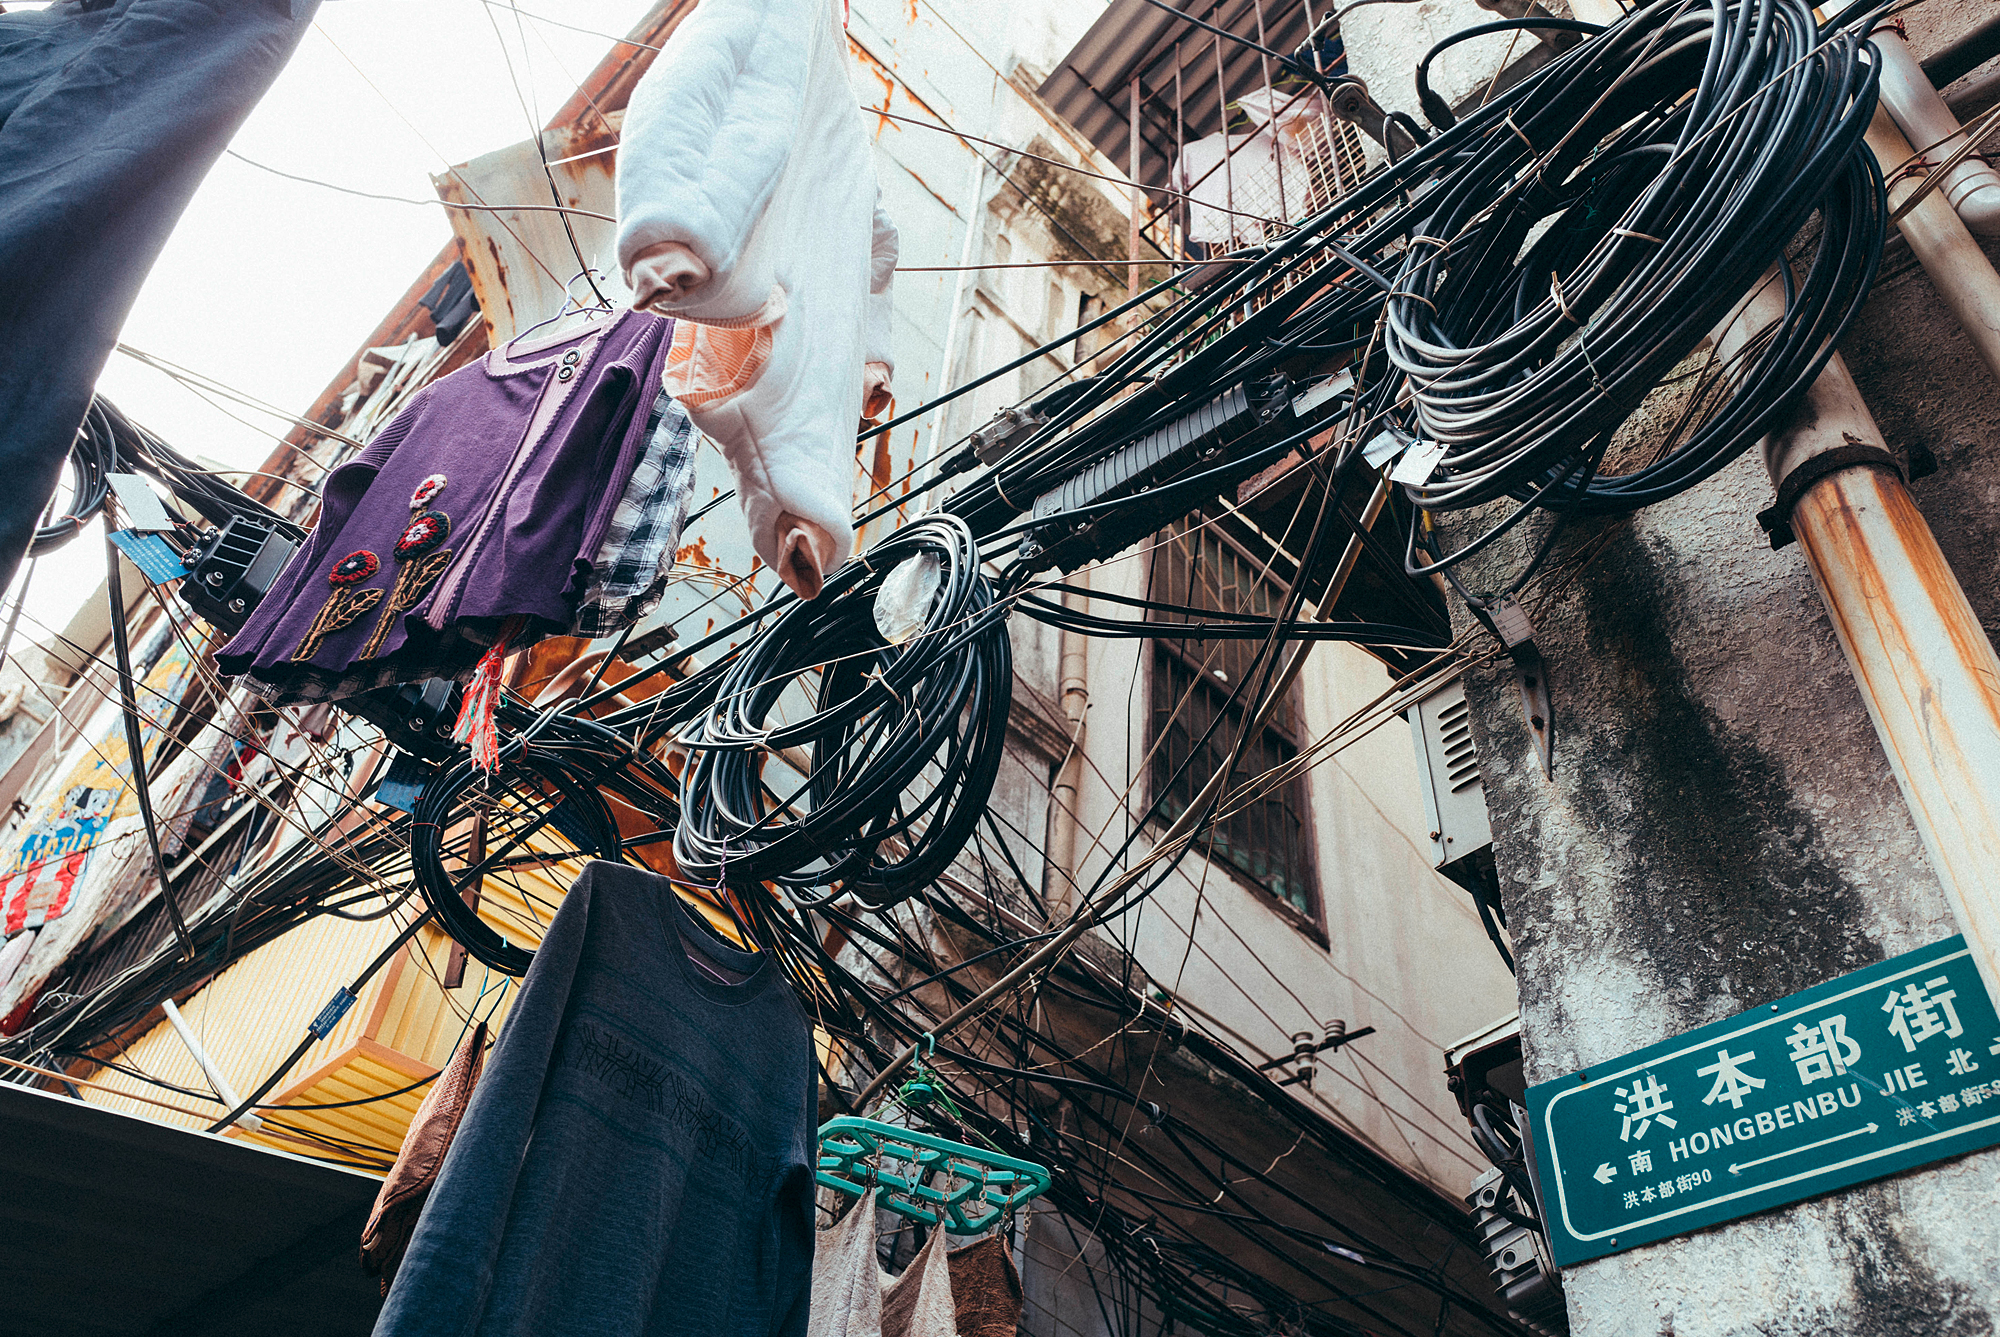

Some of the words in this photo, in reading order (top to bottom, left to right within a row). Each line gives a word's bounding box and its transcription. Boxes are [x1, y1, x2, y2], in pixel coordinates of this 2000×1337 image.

[1613, 975, 1964, 1142] 洪本部街
[1945, 1047, 1979, 1075] 北
[1668, 1083, 1862, 1162] HONGBENBU
[1879, 1062, 1928, 1096] JIE
[1627, 1149, 1653, 1176] 南
[1623, 1168, 1713, 1209] 洪本部街90
